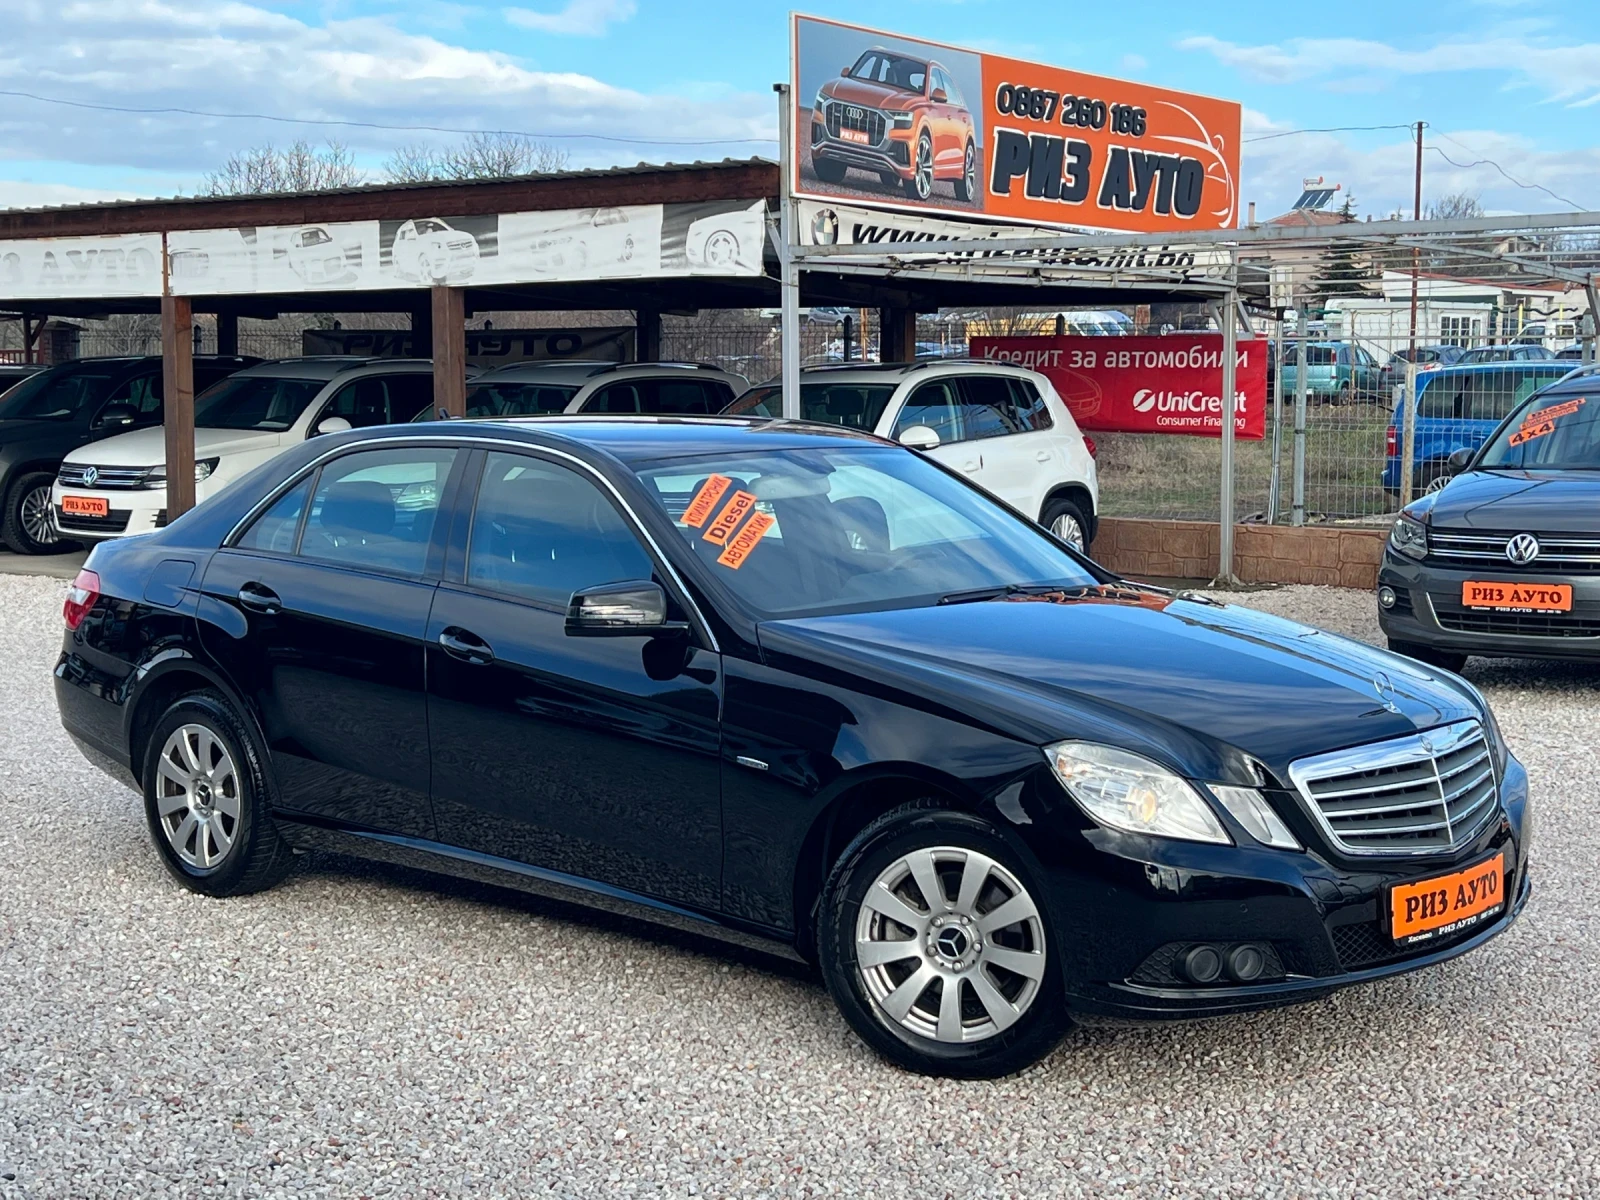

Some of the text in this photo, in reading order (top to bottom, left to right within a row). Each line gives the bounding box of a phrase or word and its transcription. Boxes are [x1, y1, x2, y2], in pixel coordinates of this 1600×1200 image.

[996, 82, 1146, 137] 0887 260 186
[990, 126, 1204, 218] РИЗ АУТО
[984, 346, 1063, 371] Кредит
[1069, 351, 1096, 368] за
[1157, 391, 1246, 412] UniCreit
[1156, 415, 1246, 429] Consumer Finang
[709, 493, 752, 539] Diesel
[724, 514, 769, 565] АВТОМАТИК
[1471, 587, 1562, 604] РИЗ АУТО
[1405, 870, 1497, 923] РИЗ АУТО
[1438, 923, 1456, 935] РИЗ
[1456, 915, 1477, 930] АУТО
